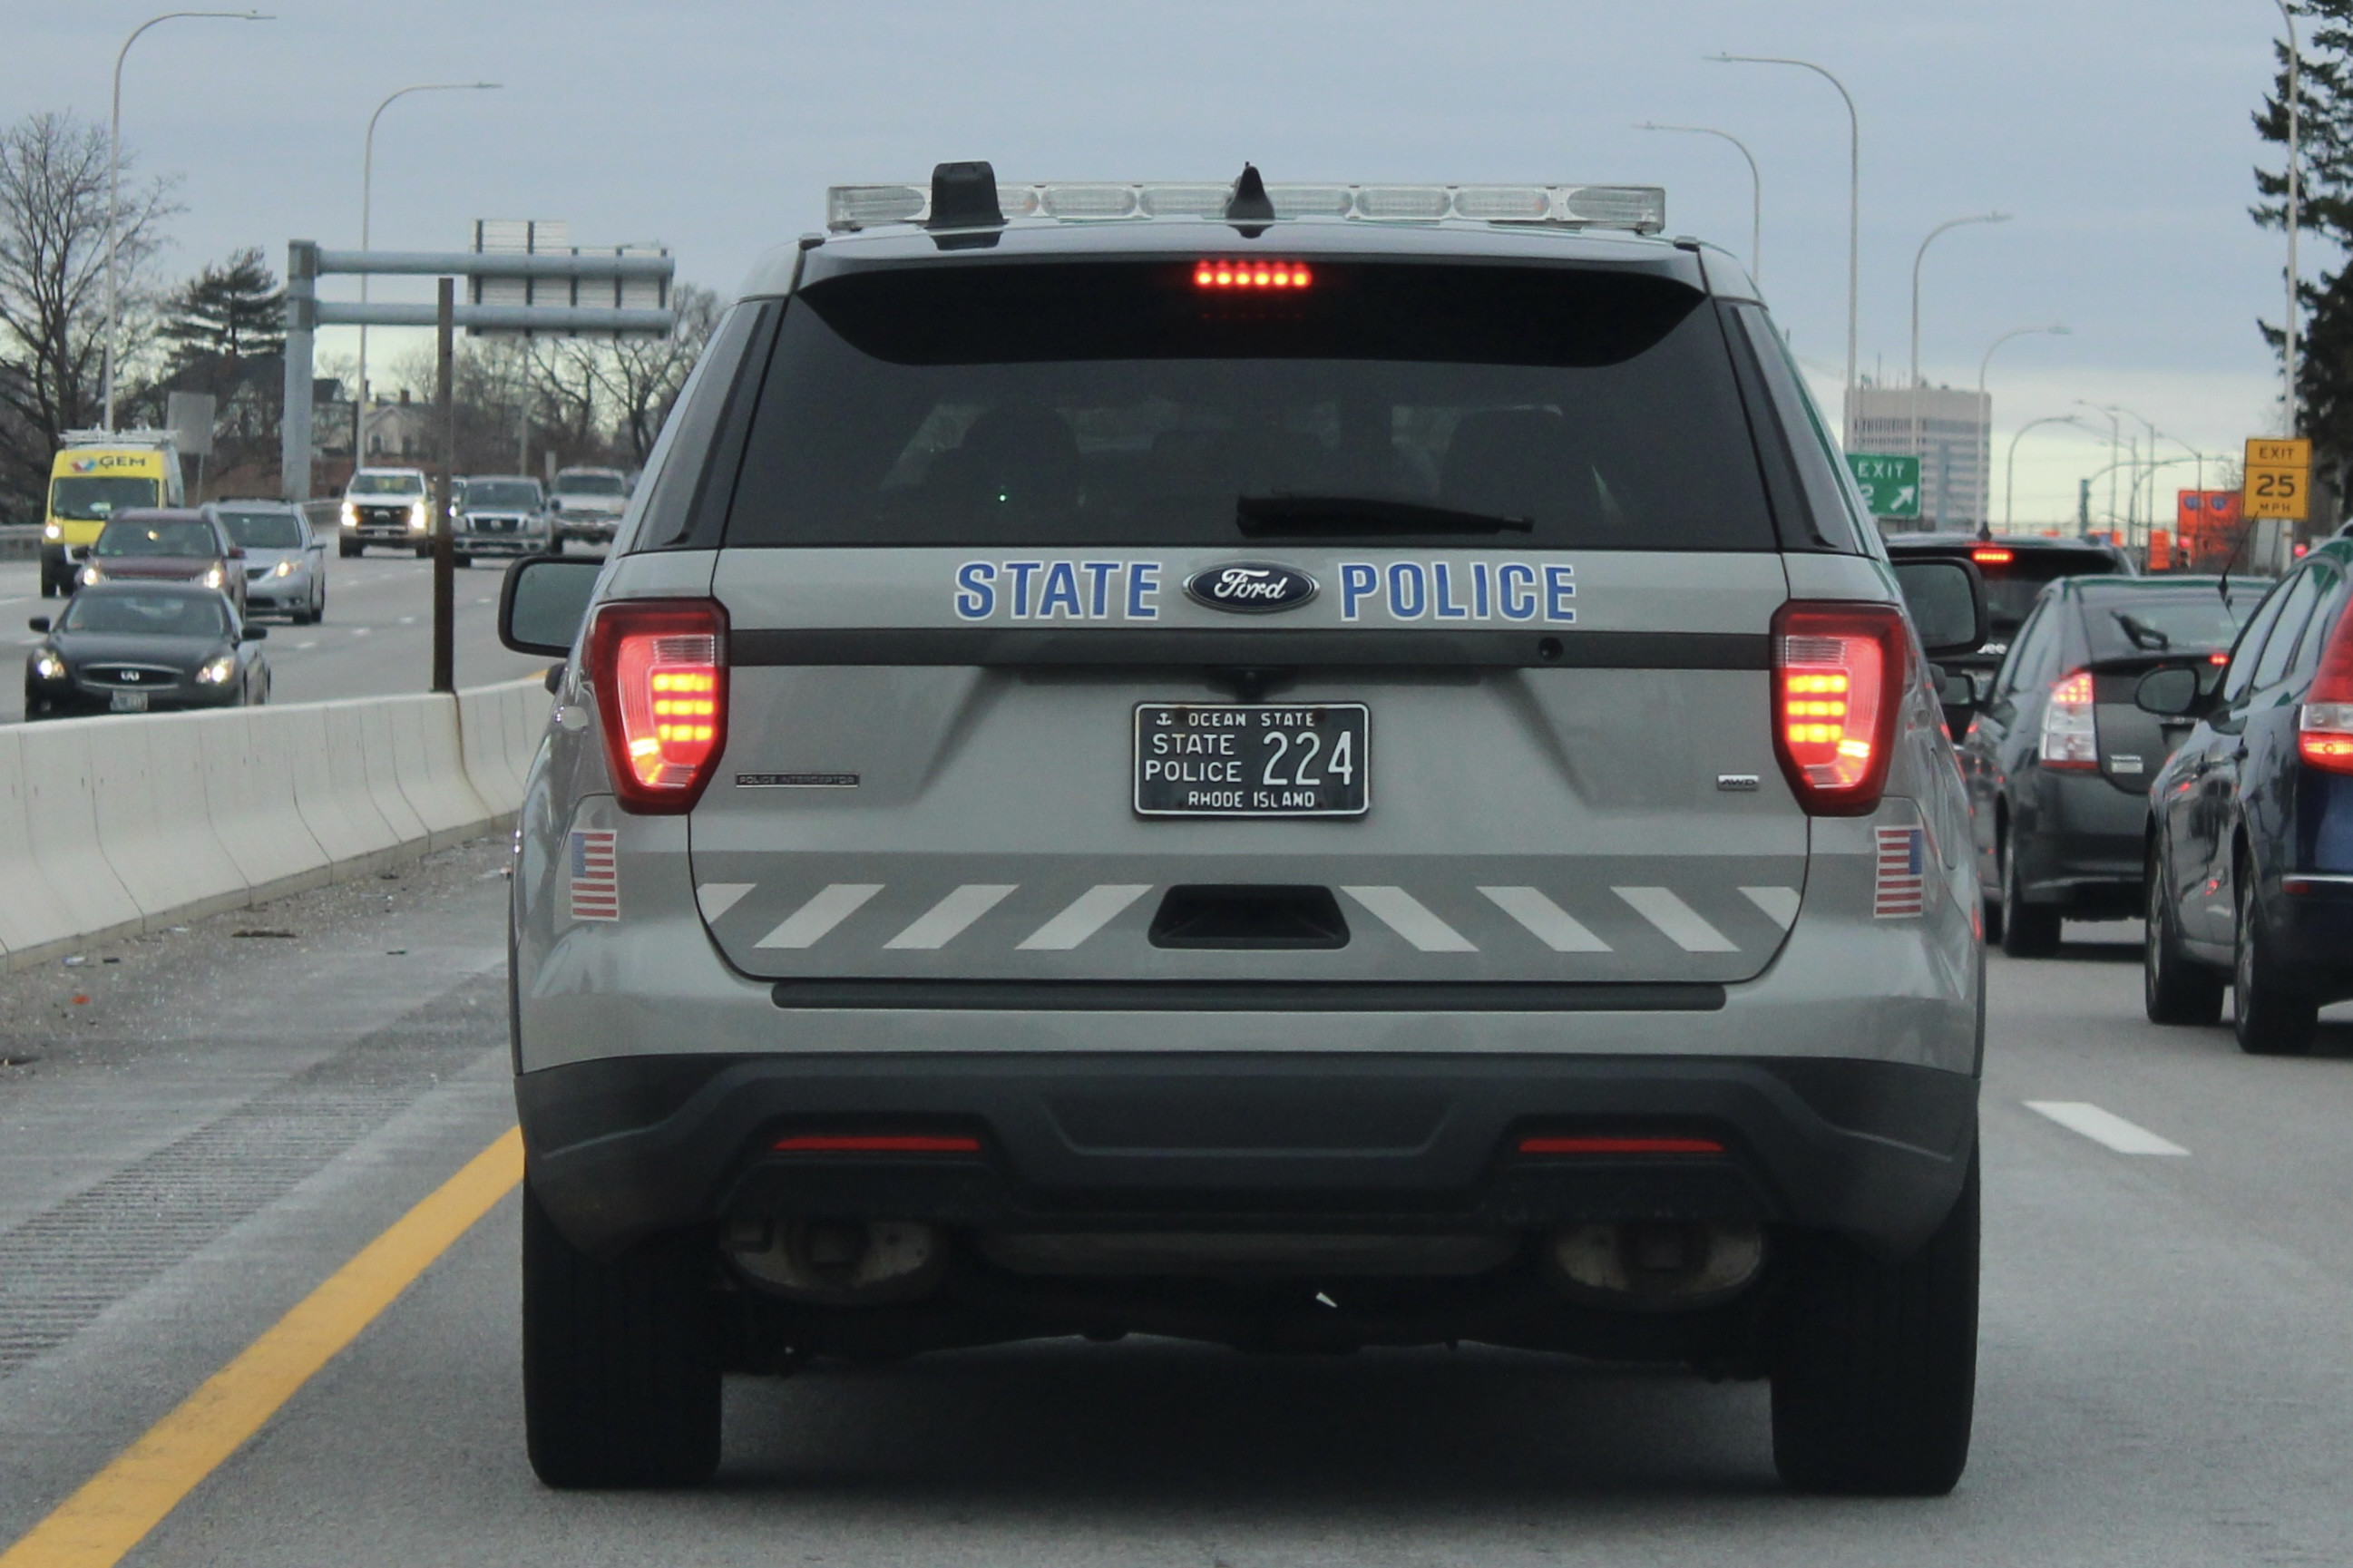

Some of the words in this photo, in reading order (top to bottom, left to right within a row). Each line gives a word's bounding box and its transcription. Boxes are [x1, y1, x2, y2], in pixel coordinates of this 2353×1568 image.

[99, 455, 145, 469] GEM
[2260, 446, 2294, 460] EXIT
[1858, 461, 1905, 479] EXIT
[2256, 474, 2295, 498] 25
[2260, 502, 2290, 512] MPH
[954, 560, 1162, 621] STATE
[1338, 560, 1577, 623] POLICE
[1214, 567, 1287, 599] Ford
[1188, 713, 1246, 726] OCEAN
[1261, 712, 1314, 726] STATE
[1153, 734, 1235, 755] STATE
[1263, 731, 1352, 785] 224
[738, 775, 776, 784] POLICE
[1145, 760, 1242, 782] POLICE
[1188, 791, 1244, 808] RHODE
[1253, 791, 1314, 808] ISLAND
